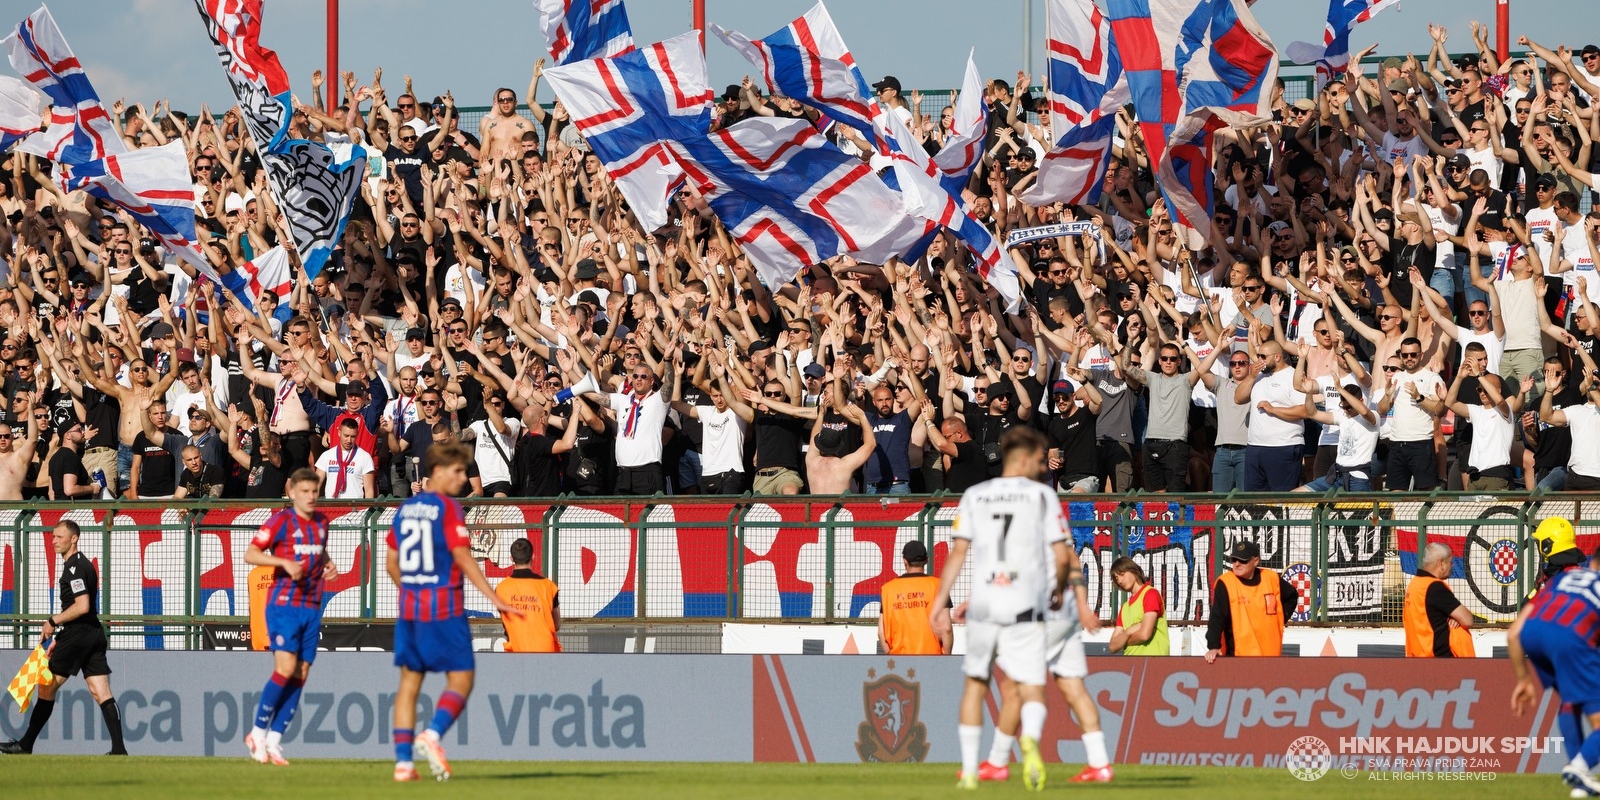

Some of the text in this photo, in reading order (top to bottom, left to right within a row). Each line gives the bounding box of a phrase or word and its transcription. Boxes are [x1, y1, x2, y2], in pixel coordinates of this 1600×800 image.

[399, 519, 434, 573] 21
[993, 513, 1014, 562] 7
[1492, 540, 1518, 554] HAJDU
[488, 678, 646, 748] vrata
[1154, 671, 1481, 739] SuperSport
